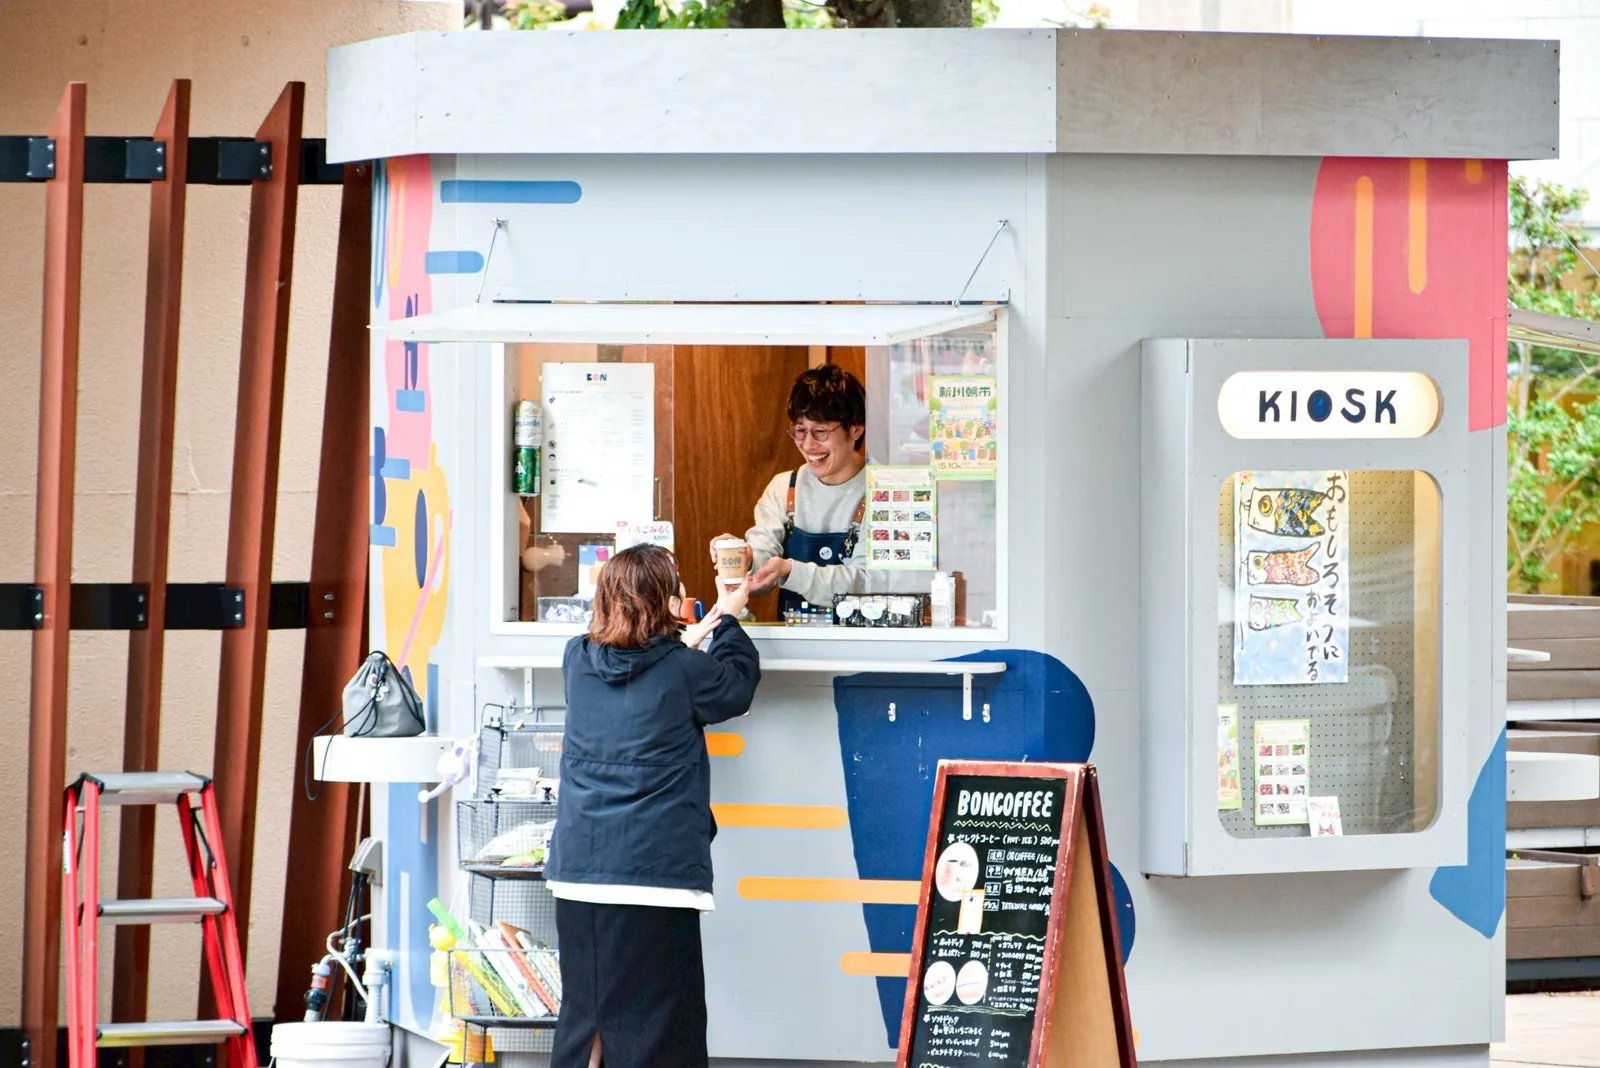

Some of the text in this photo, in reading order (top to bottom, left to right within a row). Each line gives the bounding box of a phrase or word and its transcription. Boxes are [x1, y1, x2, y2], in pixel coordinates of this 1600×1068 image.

[938, 386, 991, 398] 新川朝市
[1258, 388, 1397, 425] KIOSK
[957, 790, 1053, 818] BONCOFFEE
